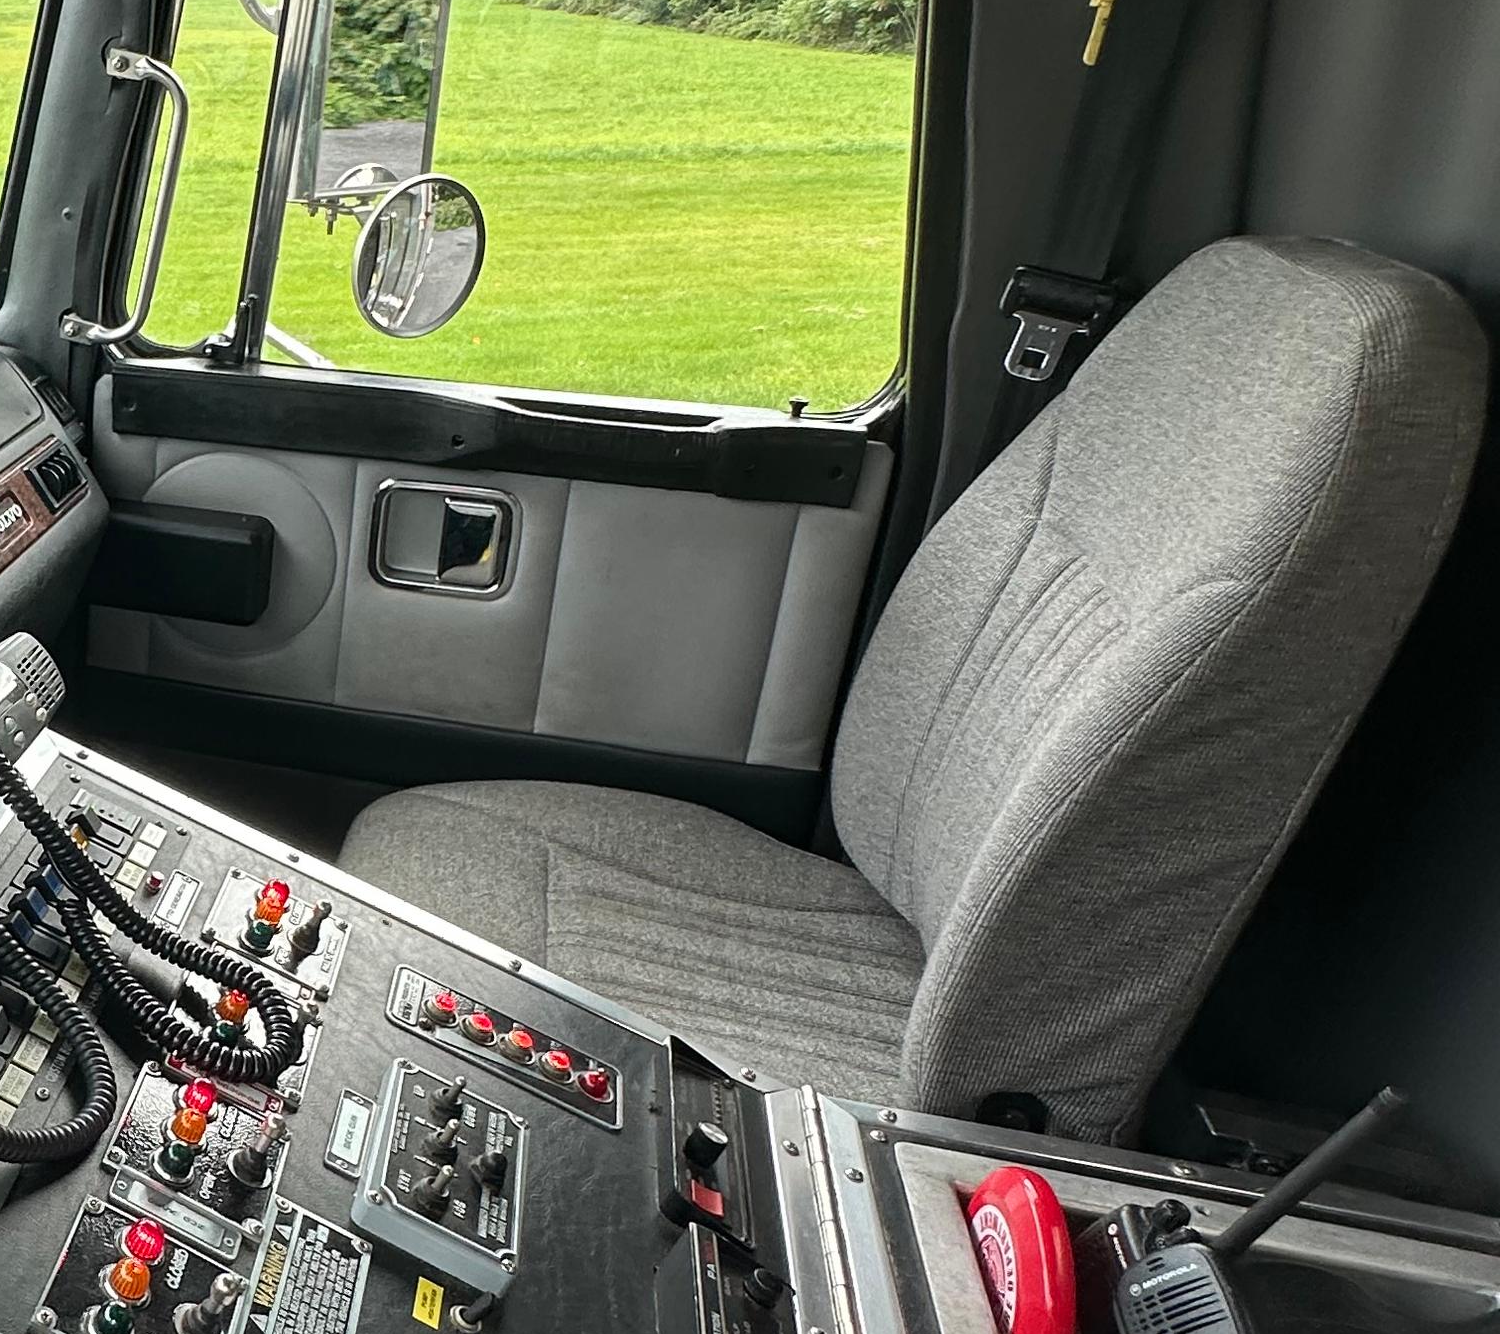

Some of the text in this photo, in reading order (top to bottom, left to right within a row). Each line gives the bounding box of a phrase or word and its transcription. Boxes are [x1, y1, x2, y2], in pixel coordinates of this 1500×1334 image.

[200, 1169, 217, 1200] OPEN
[164, 1248, 190, 1290] CLOSED
[254, 1241, 288, 1308] WARNING
[707, 1263, 717, 1280] PA
[1142, 1263, 1197, 1289] MOTOROLA
